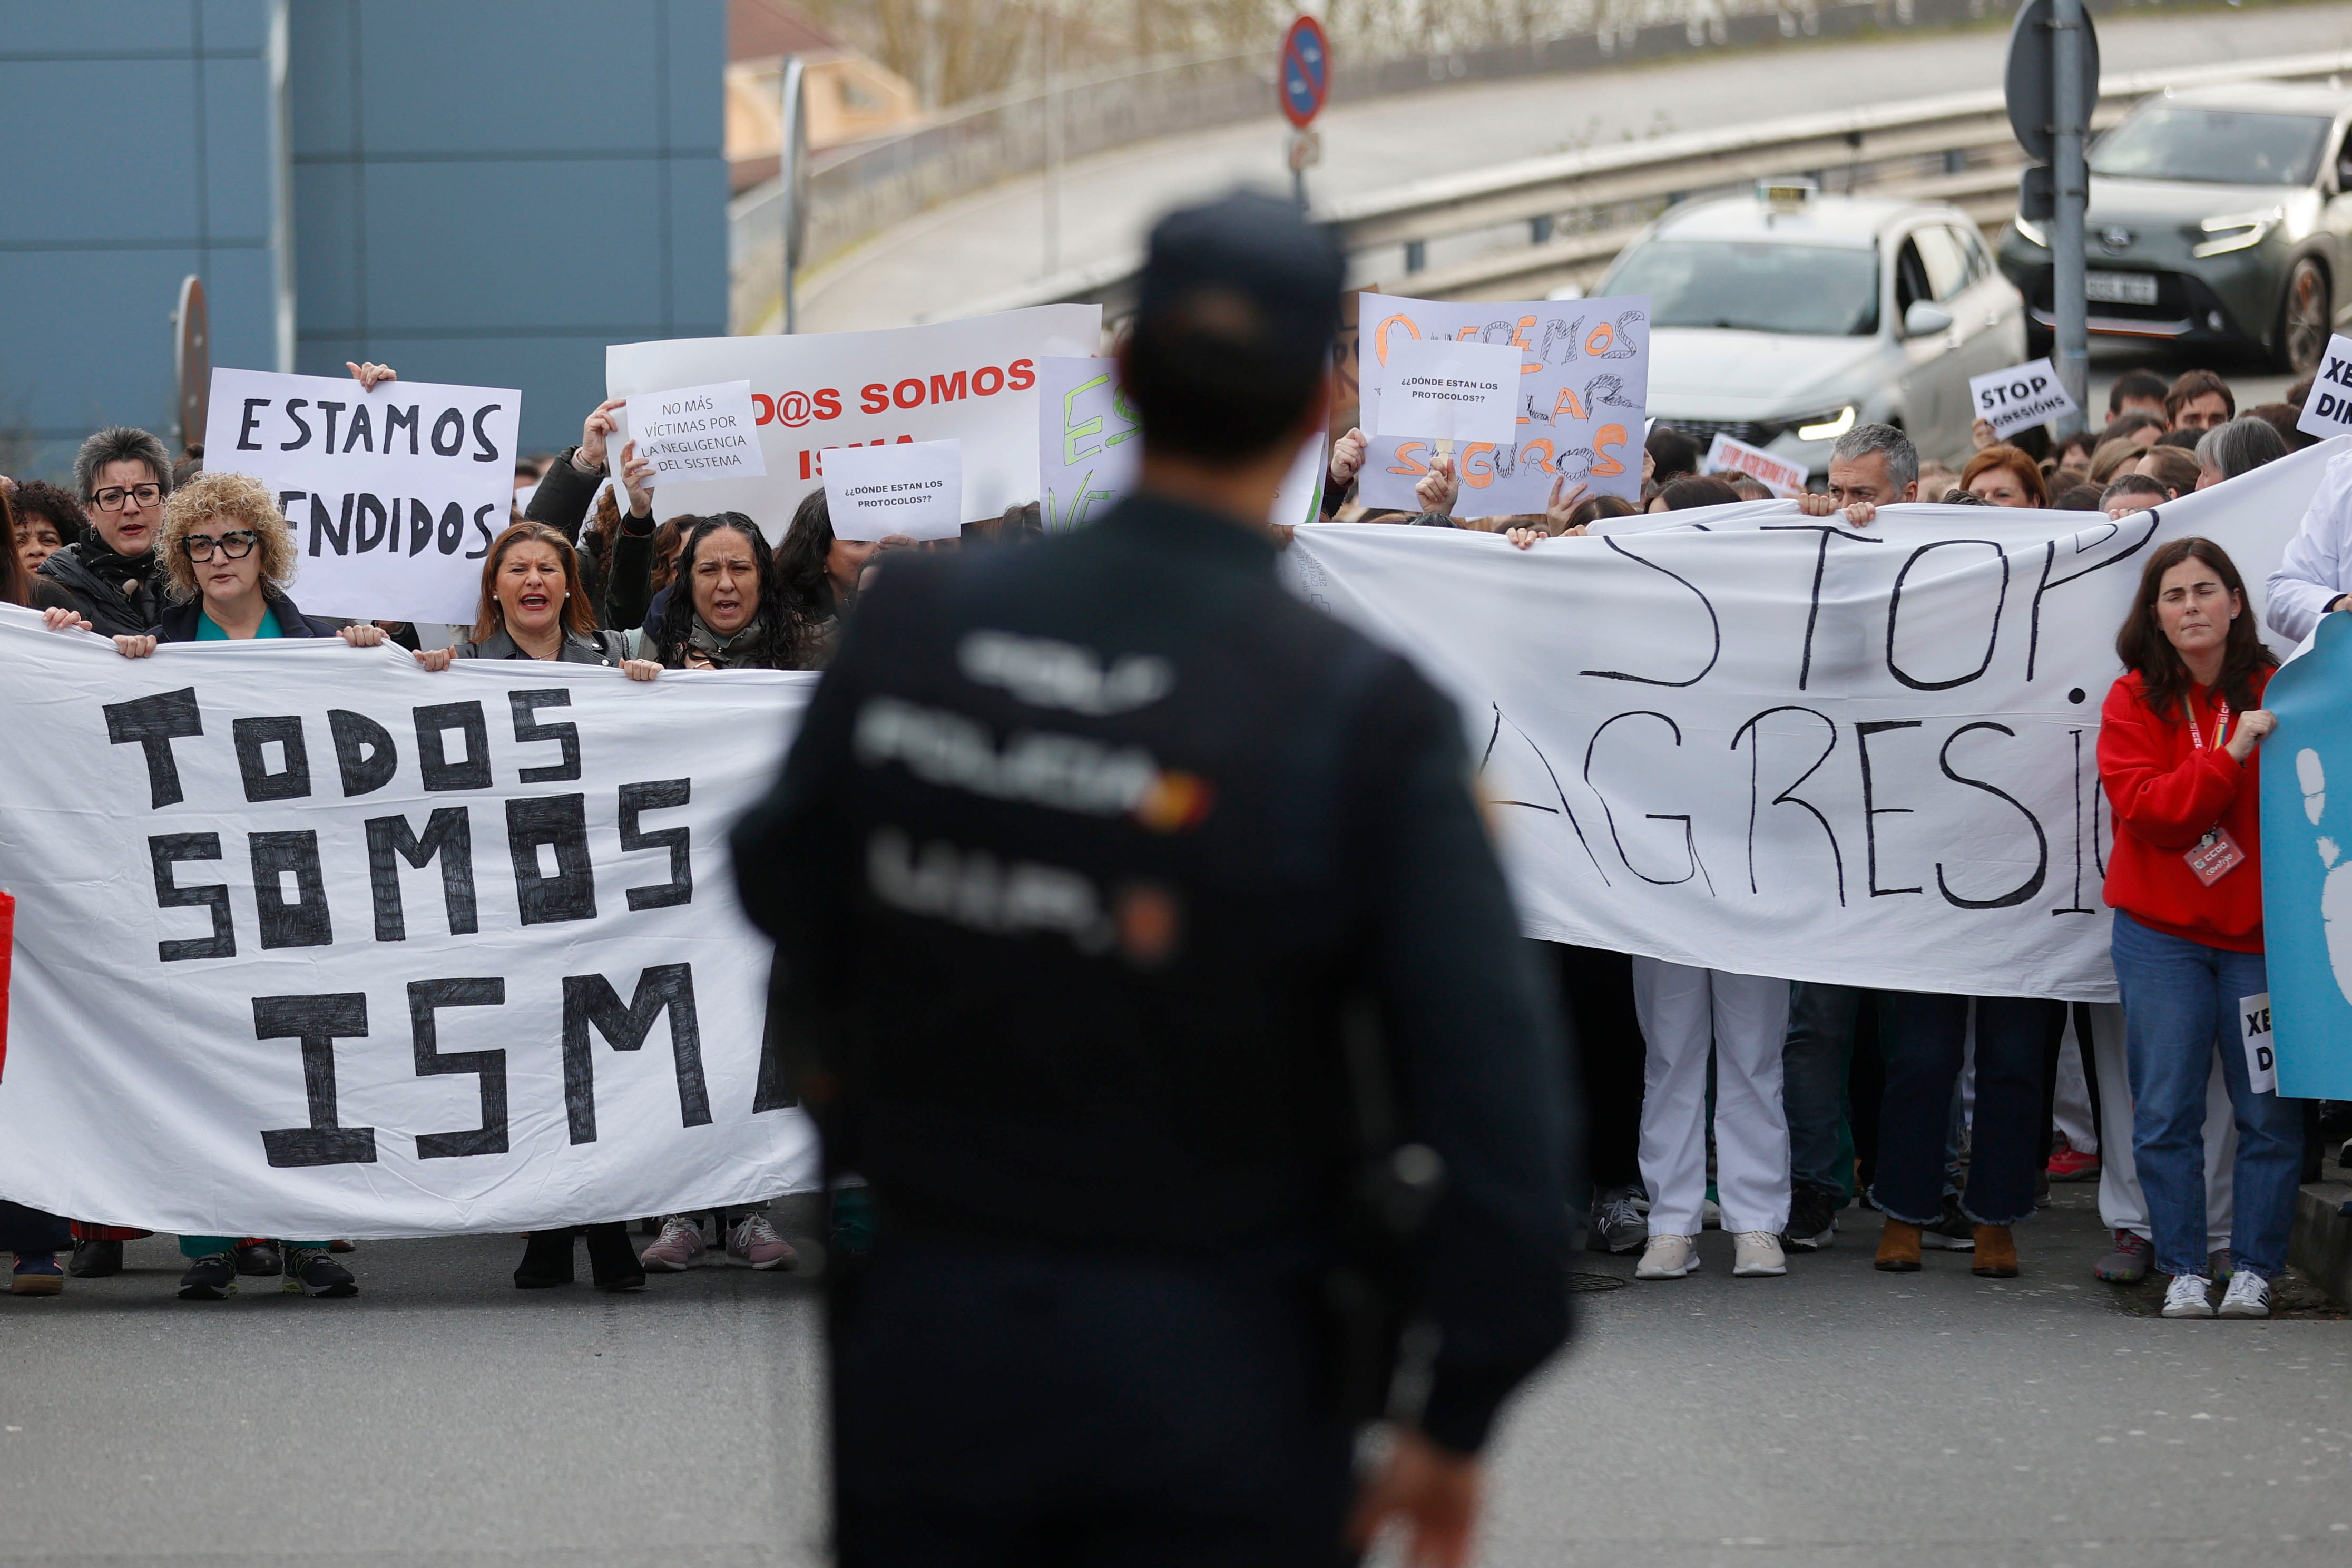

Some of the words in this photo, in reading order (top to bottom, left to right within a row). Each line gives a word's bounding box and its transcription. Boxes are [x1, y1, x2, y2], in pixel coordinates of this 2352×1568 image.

[860, 358, 1036, 414] SOMOS
[1401, 376, 1444, 386] ¿¿DÓNDE
[1446, 379, 1477, 388] ESTAN
[1981, 377, 2047, 409] STOP
[663, 402, 681, 415] NO
[685, 395, 713, 413] MÁS
[1412, 391, 1485, 403] PROTOCOLOS??
[237, 398, 503, 462] ESTAMOS
[645, 419, 706, 438] VÍCTIMAS
[710, 415, 737, 429] POR
[641, 446, 659, 458] LA
[661, 435, 747, 454] NEGLIGENCIA
[1386, 424, 1627, 489] SGUROS
[658, 459, 683, 472] DEL
[684, 454, 742, 469] SISTEMA
[845, 485, 888, 496] ¿¿DÓNDE
[891, 482, 922, 492] ESTAN
[925, 480, 943, 488] LOS
[858, 495, 932, 507] PROTOCOLOS??
[1579, 509, 2159, 691] STOP
[102, 686, 583, 810] TODOS
[1478, 687, 2106, 917] AGRESI
[2203, 842, 2228, 861] CCOO
[148, 777, 693, 962] SOMOS
